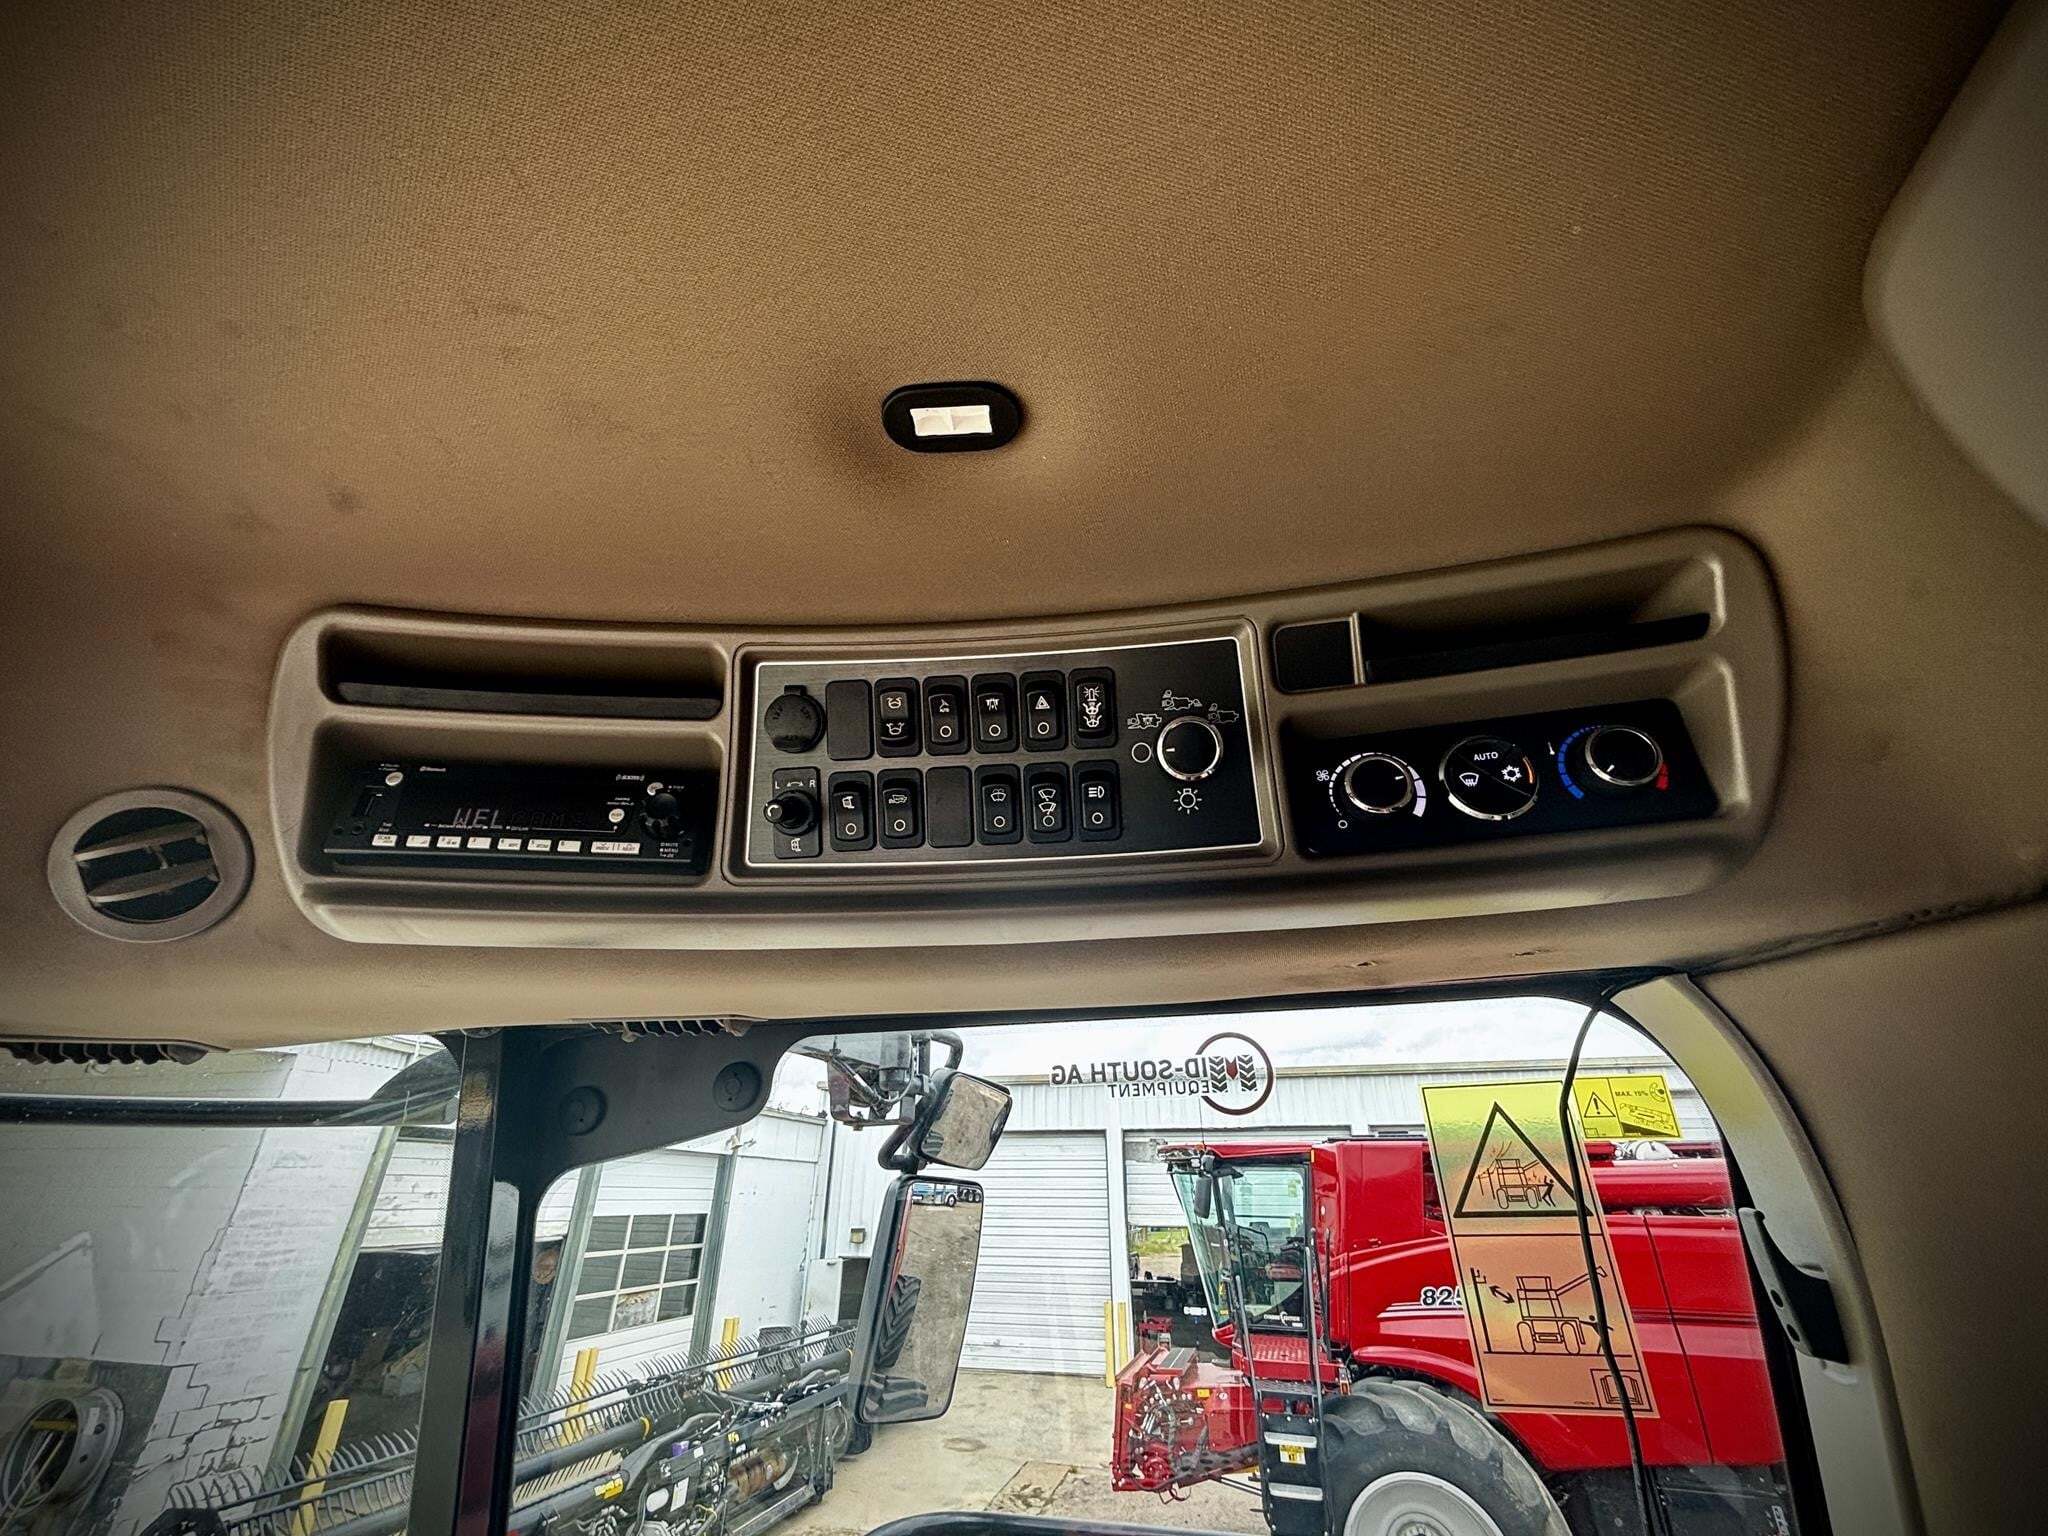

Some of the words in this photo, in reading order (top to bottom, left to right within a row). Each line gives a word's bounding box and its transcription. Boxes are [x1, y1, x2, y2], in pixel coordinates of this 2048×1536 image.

[1473, 751, 1499, 761] AUTO
[774, 781, 780, 790] L
[809, 779, 816, 788] R
